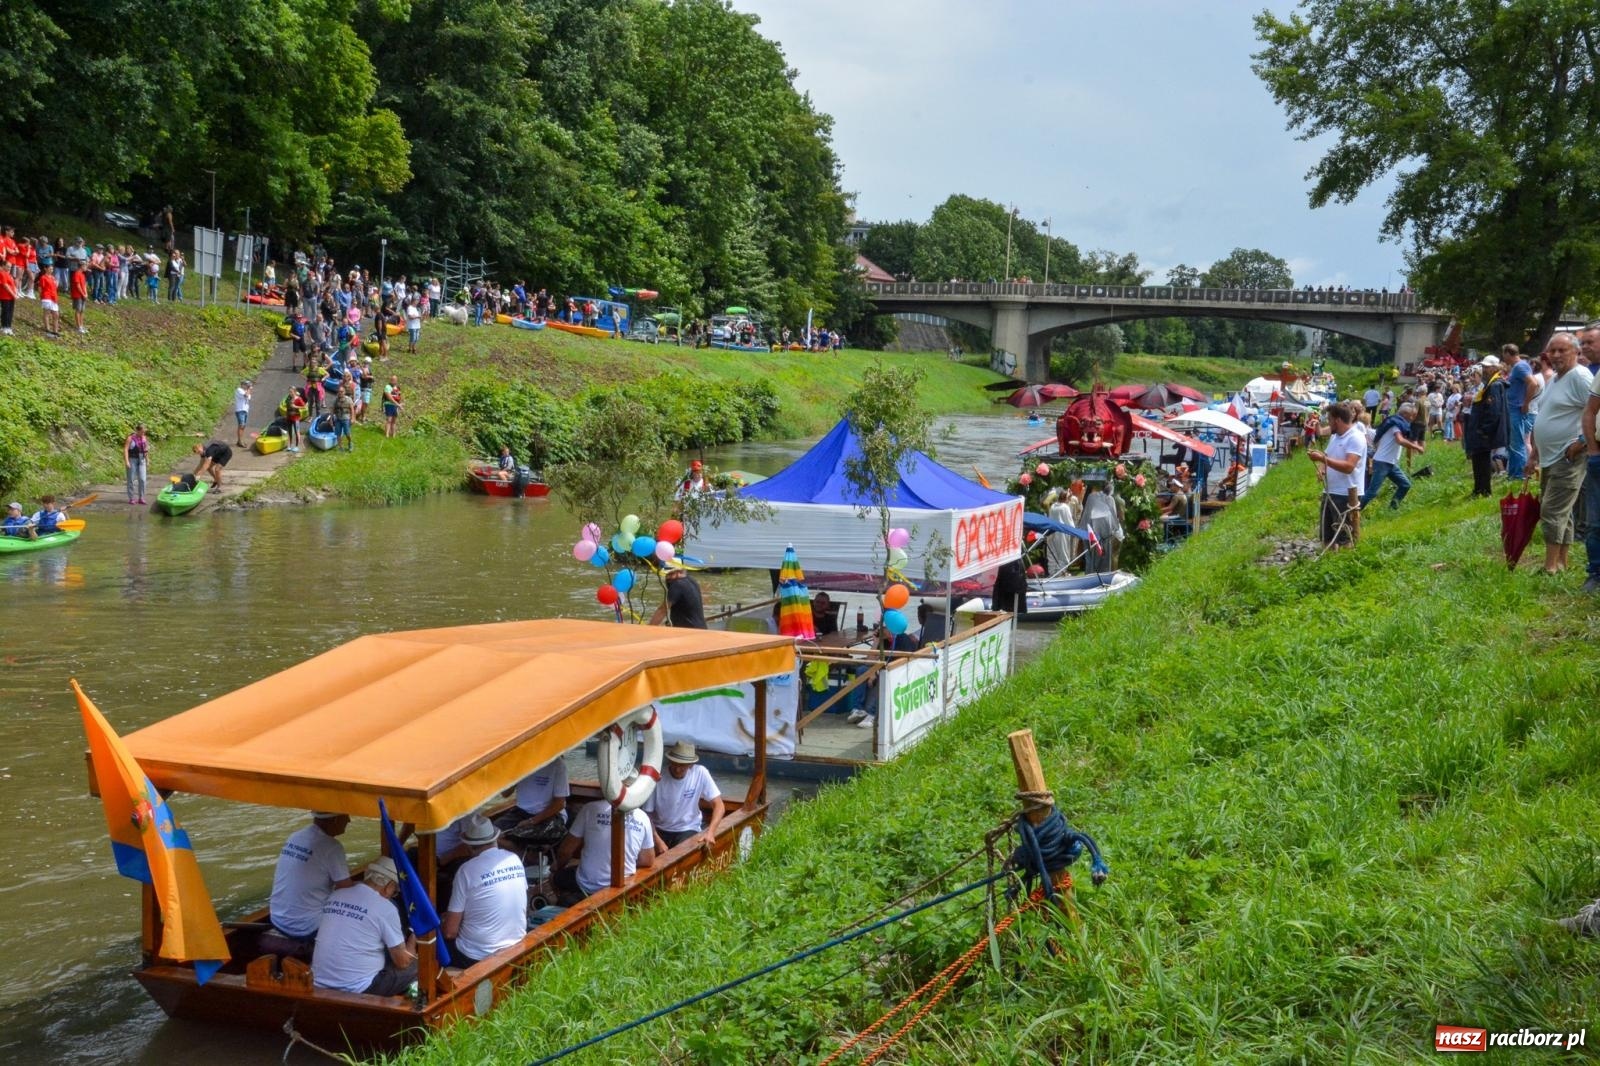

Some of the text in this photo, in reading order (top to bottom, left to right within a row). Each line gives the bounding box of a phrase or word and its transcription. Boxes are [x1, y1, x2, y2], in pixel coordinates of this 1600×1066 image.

[956, 503, 1023, 569] OPOROWO
[959, 633, 1003, 697] CISEK
[346, 911, 364, 921] 2024
